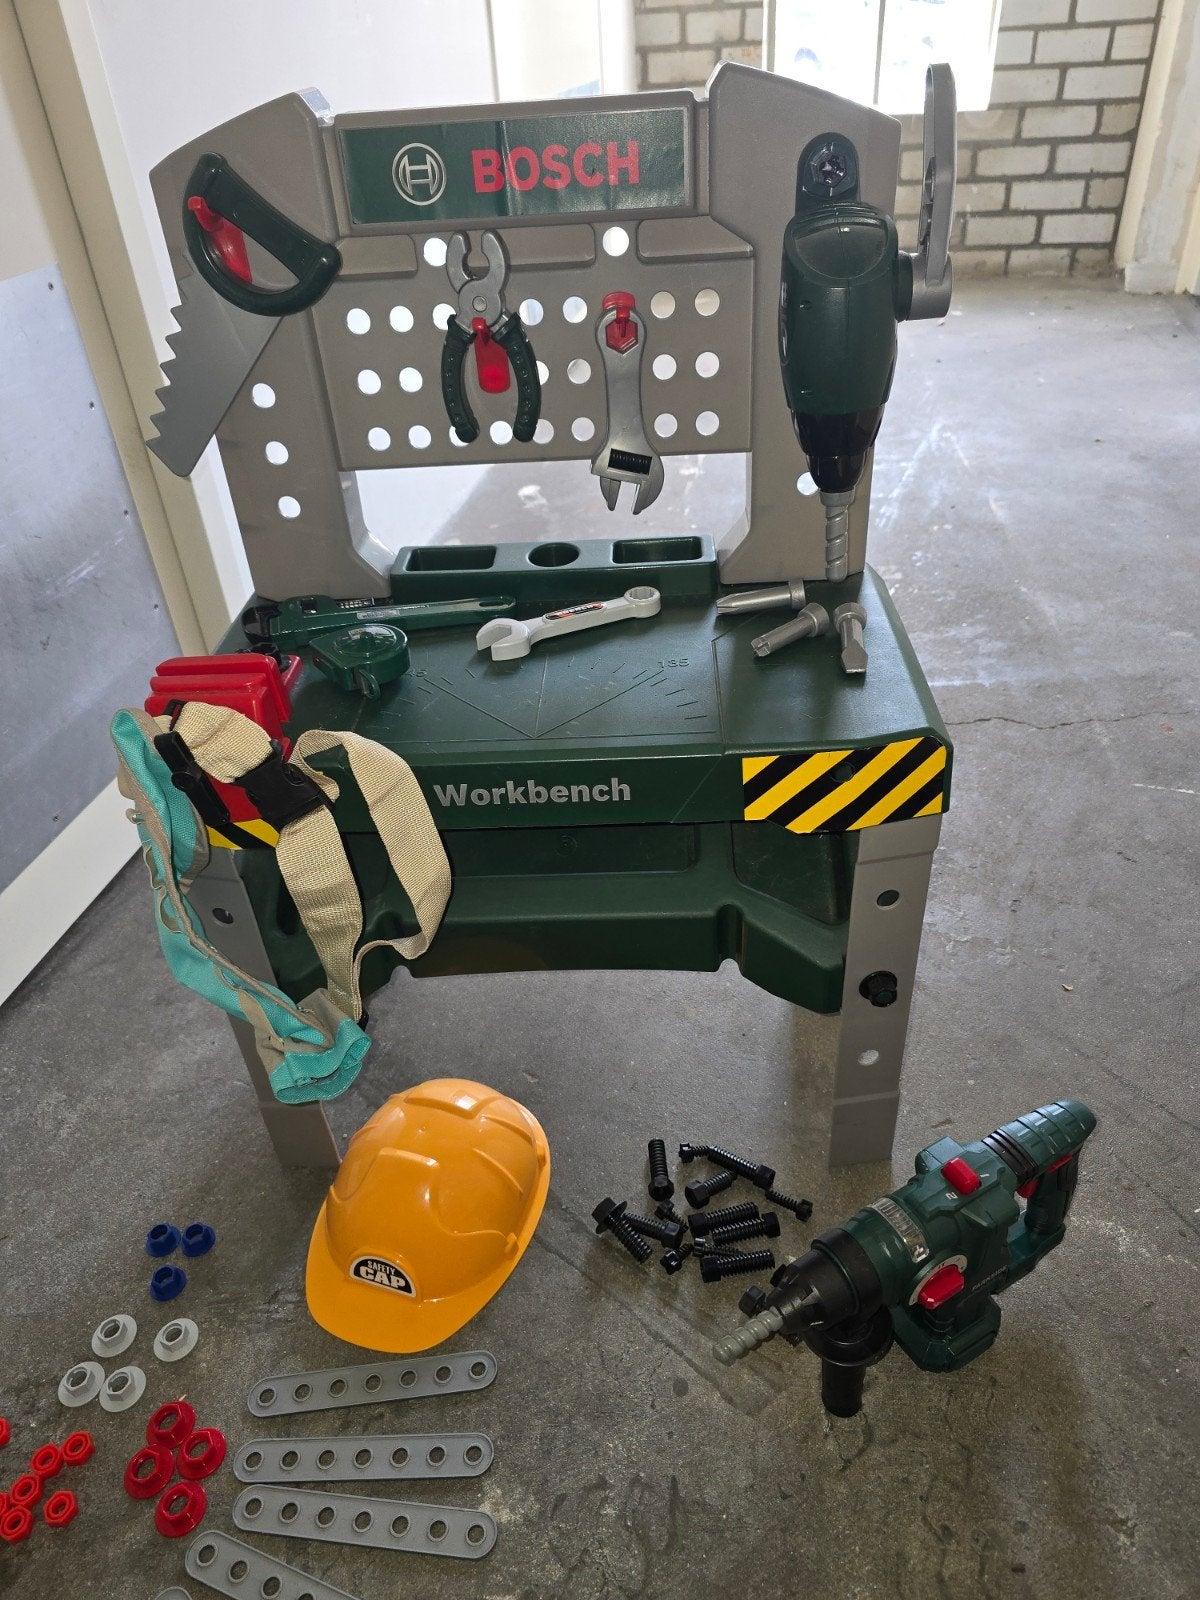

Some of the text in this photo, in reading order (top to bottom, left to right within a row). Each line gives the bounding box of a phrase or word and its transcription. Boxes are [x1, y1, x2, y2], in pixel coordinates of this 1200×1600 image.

[472, 140, 639, 193] BOSCH
[657, 658, 689, 668] 135
[433, 777, 631, 806] Workbench
[359, 1266, 405, 1288] CAP
[367, 1260, 395, 1275] SAFETY
